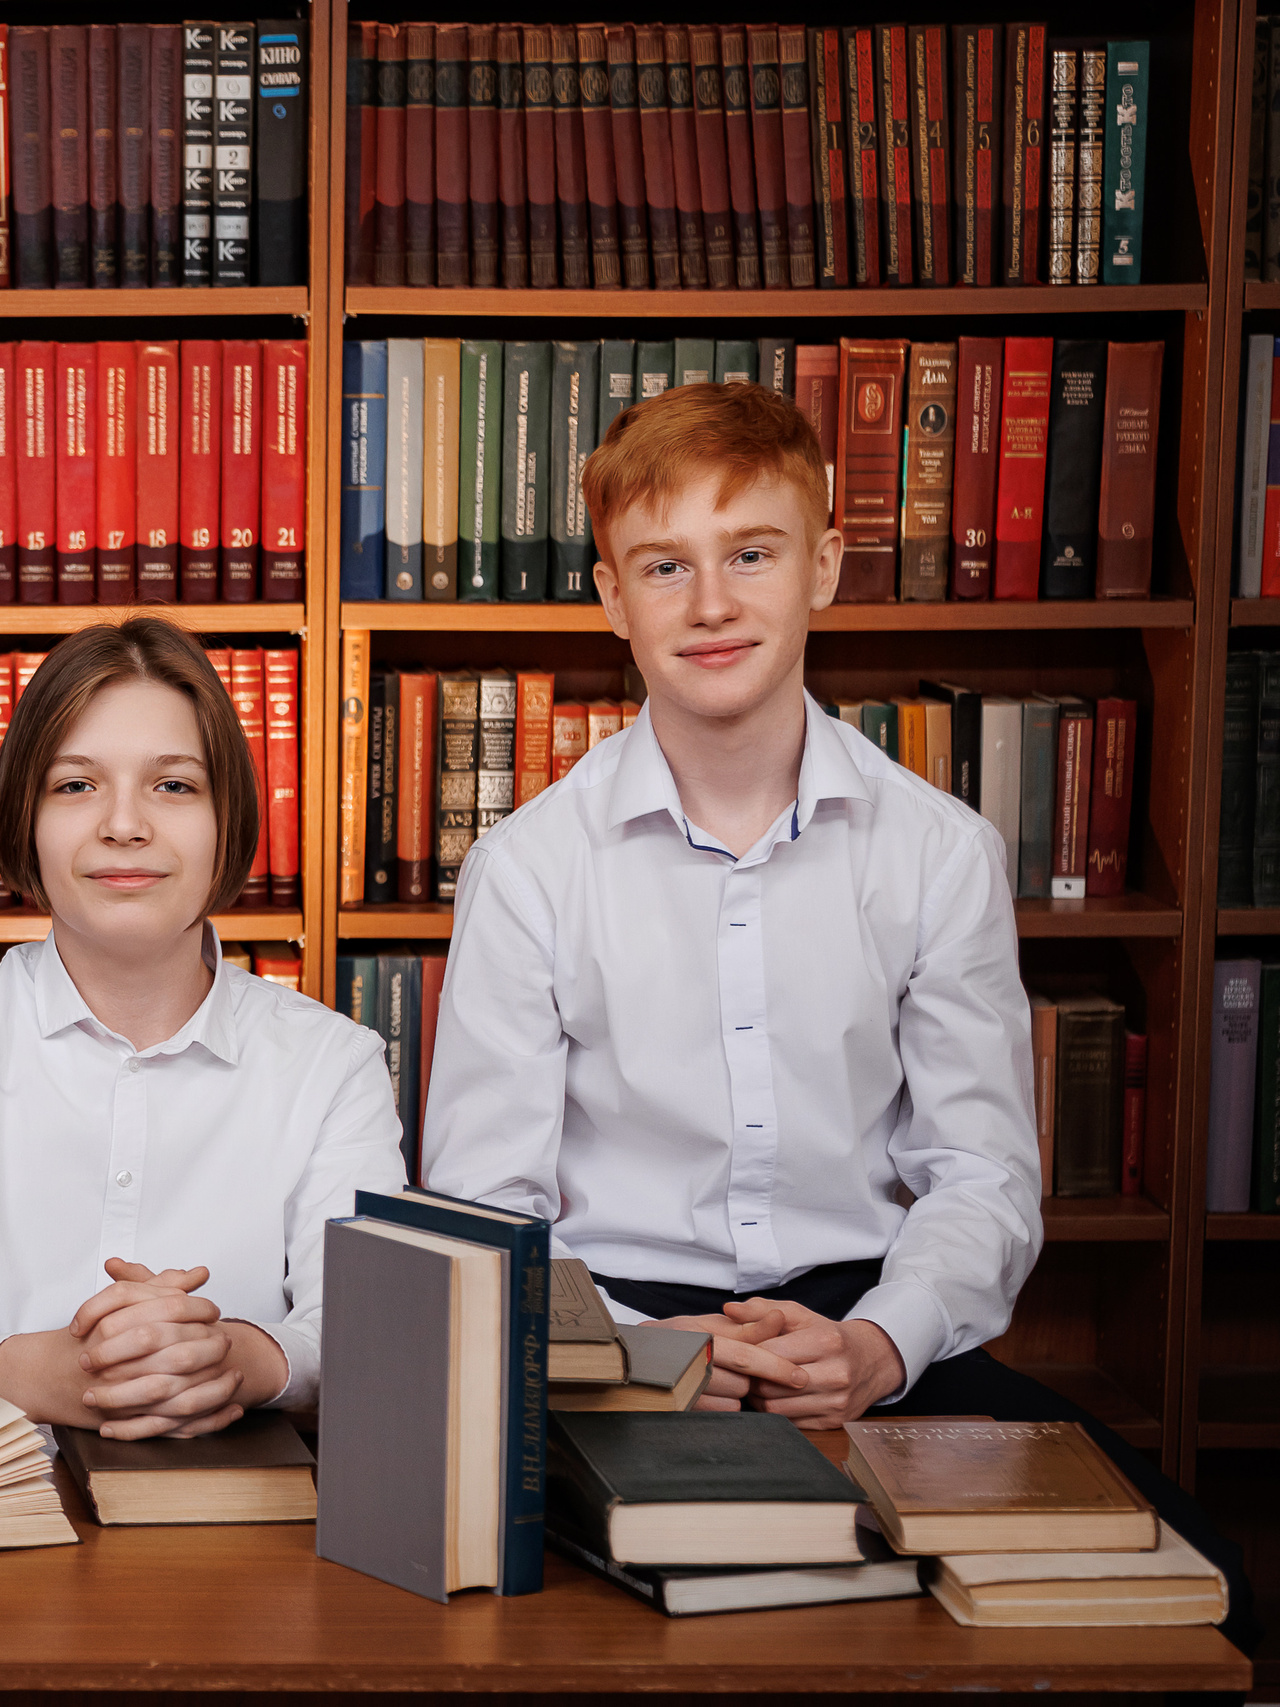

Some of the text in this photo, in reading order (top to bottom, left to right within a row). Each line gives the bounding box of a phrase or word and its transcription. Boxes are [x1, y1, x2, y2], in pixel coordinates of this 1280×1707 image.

[260, 46, 300, 65] КИНО
[260, 72, 300, 87] СЛОВАРЬ
[831, 123, 837, 149] 1
[859, 122, 874, 149] 2
[896, 119, 909, 147] 3
[930, 120, 942, 147] 4
[978, 124, 990, 150] 5
[1027, 119, 1040, 147] 6
[229, 151, 238, 166] 2
[1118, 239, 1129, 255] 5
[922, 369, 947, 384] Даль
[518, 370, 529, 413] СЛОВАРЬ
[1006, 417, 1046, 426] ТОЛКОВЫЙ
[1117, 420, 1149, 430] СЛОВАРЬ
[1007, 435, 1044, 443] РУССКОГО
[1116, 432, 1150, 442] РУССКОГО
[1012, 443, 1038, 451] ЯЗЫКА
[1118, 444, 1147, 454] ЯЗЫКА
[1011, 507, 1033, 519] А-Я
[27, 531, 45, 550] 15
[68, 530, 87, 549] 16
[107, 530, 125, 549] 17
[149, 528, 166, 548] 18
[191, 528, 210, 548] 19
[231, 528, 253, 548] 20
[278, 527, 297, 547] 21
[965, 529, 986, 548] 30
[568, 572, 581, 590] II
[1066, 722, 1075, 759] СЛОВАРЬ
[1064, 761, 1072, 804] ТОЛКОВЫЙ
